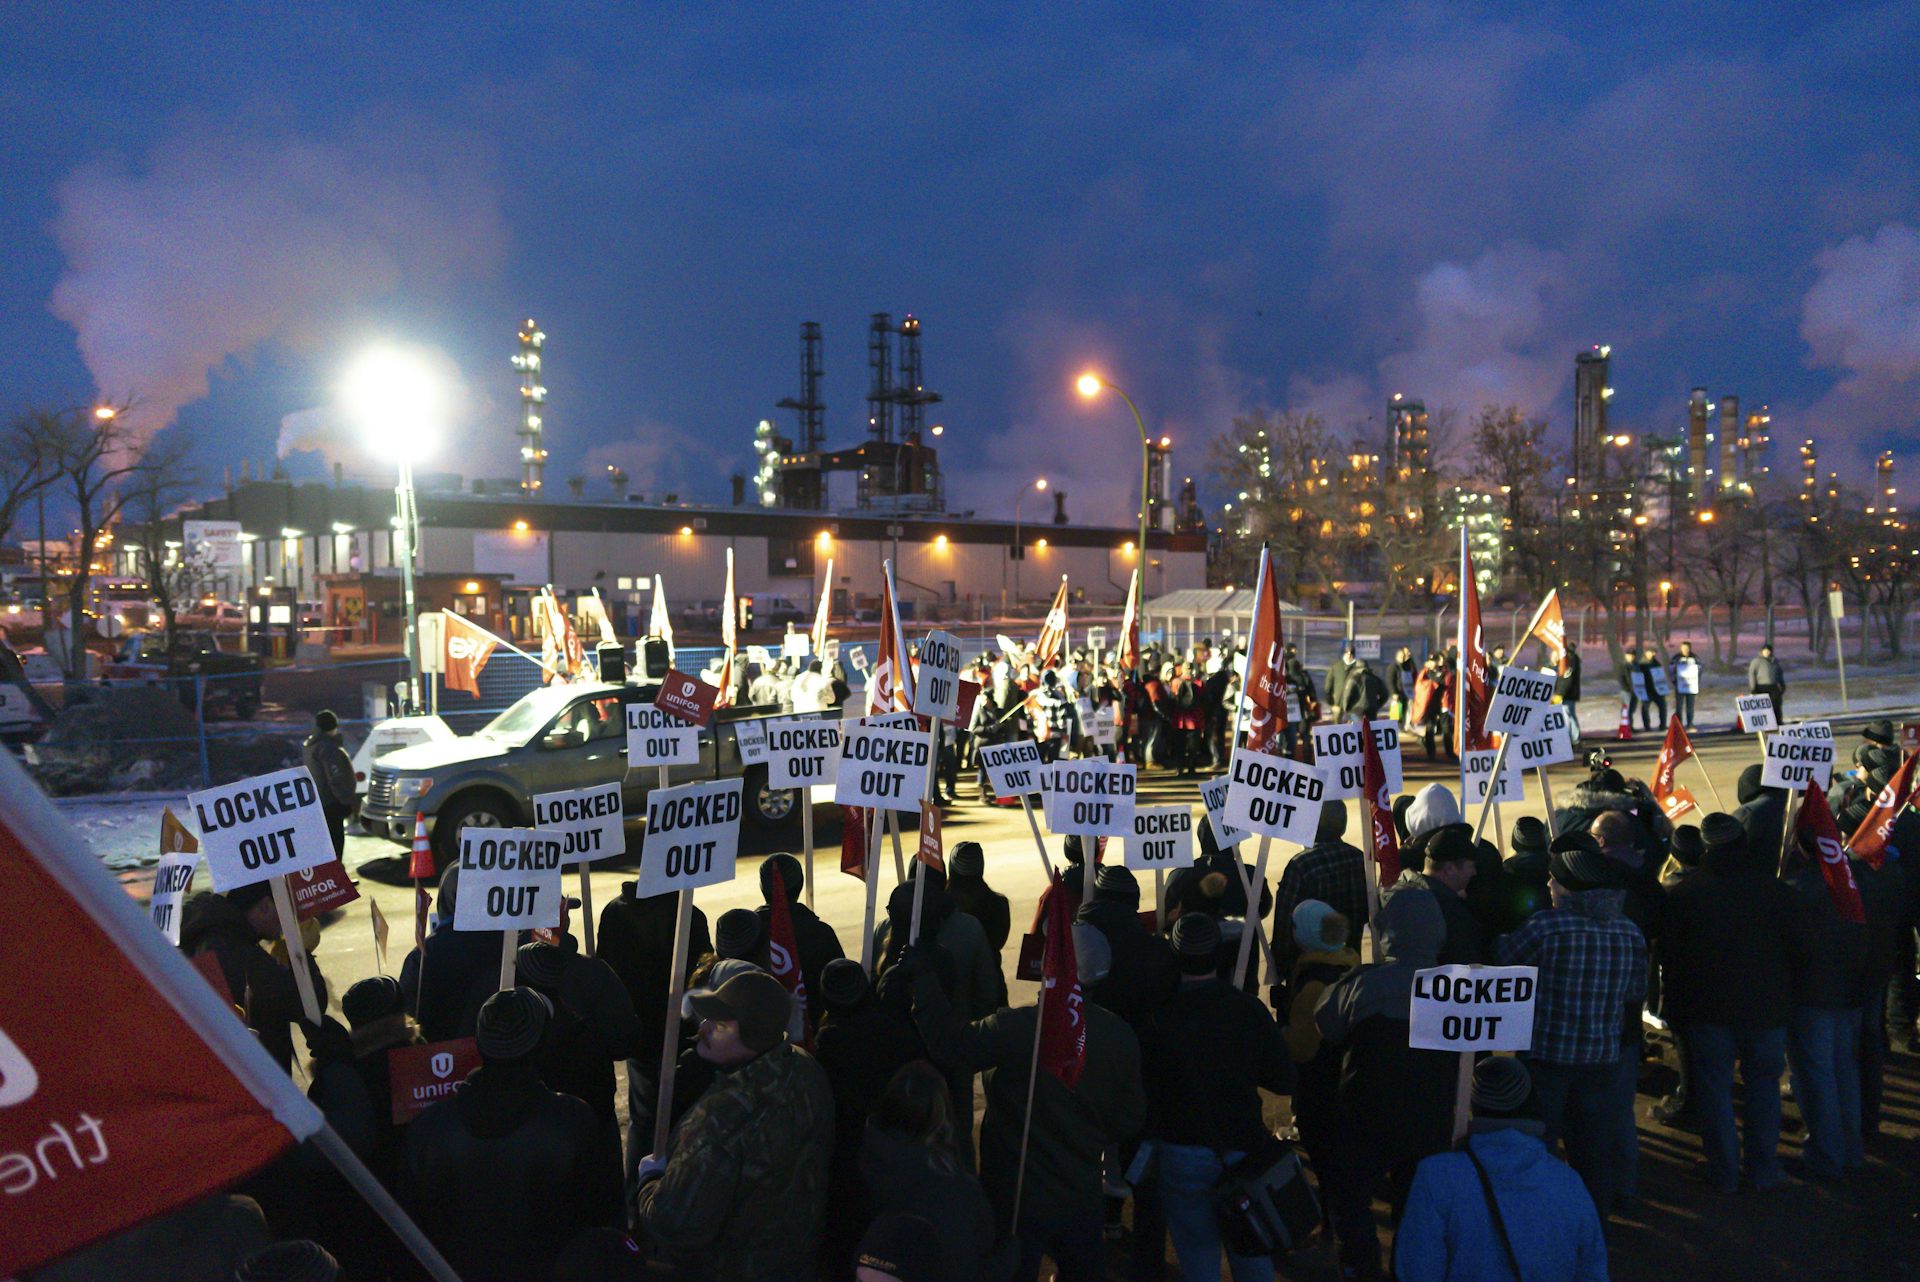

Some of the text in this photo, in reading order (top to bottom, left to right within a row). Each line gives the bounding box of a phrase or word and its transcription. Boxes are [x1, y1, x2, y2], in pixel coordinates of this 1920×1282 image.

[921, 640, 960, 674] LOCKED
[930, 677, 952, 706] OUT
[1498, 675, 1553, 702] LOCKED
[1502, 704, 1532, 726] OUT
[1738, 698, 1772, 711] LOCKED
[1751, 714, 1768, 727] OUT
[1781, 726, 1830, 739] OCKED
[646, 738, 680, 758] OUT
[739, 737, 765, 747] LOCKED
[769, 729, 840, 751] LOCKED
[842, 736, 929, 767] LOCKED
[1521, 739, 1553, 759] OUT
[1768, 742, 1832, 762] LOCKED
[748, 748, 761, 757] OUT
[983, 746, 1038, 769] LOCKED
[788, 756, 825, 778] OUT
[1340, 766, 1366, 789] OU
[1781, 765, 1814, 782] OUT
[860, 770, 905, 798] OUT
[1004, 770, 1032, 789] OUT
[1055, 770, 1134, 796] LOCKED
[1233, 759, 1324, 801] LOCKED
[196, 777, 317, 834] LOCKED
[536, 791, 620, 825] LOCKED
[648, 790, 740, 835] LOCKED
[1073, 802, 1114, 825] OUT
[1249, 797, 1297, 829] OUT
[1134, 813, 1191, 835] OCKED
[239, 828, 297, 870] OUT
[563, 828, 603, 855] OUT
[1142, 840, 1176, 861] OUT
[462, 839, 561, 871] LOCKED
[665, 841, 717, 878] OUT
[486, 885, 540, 917] OUT
[1414, 974, 1533, 1004] LOCKED
[1442, 1015, 1502, 1041] OUT
